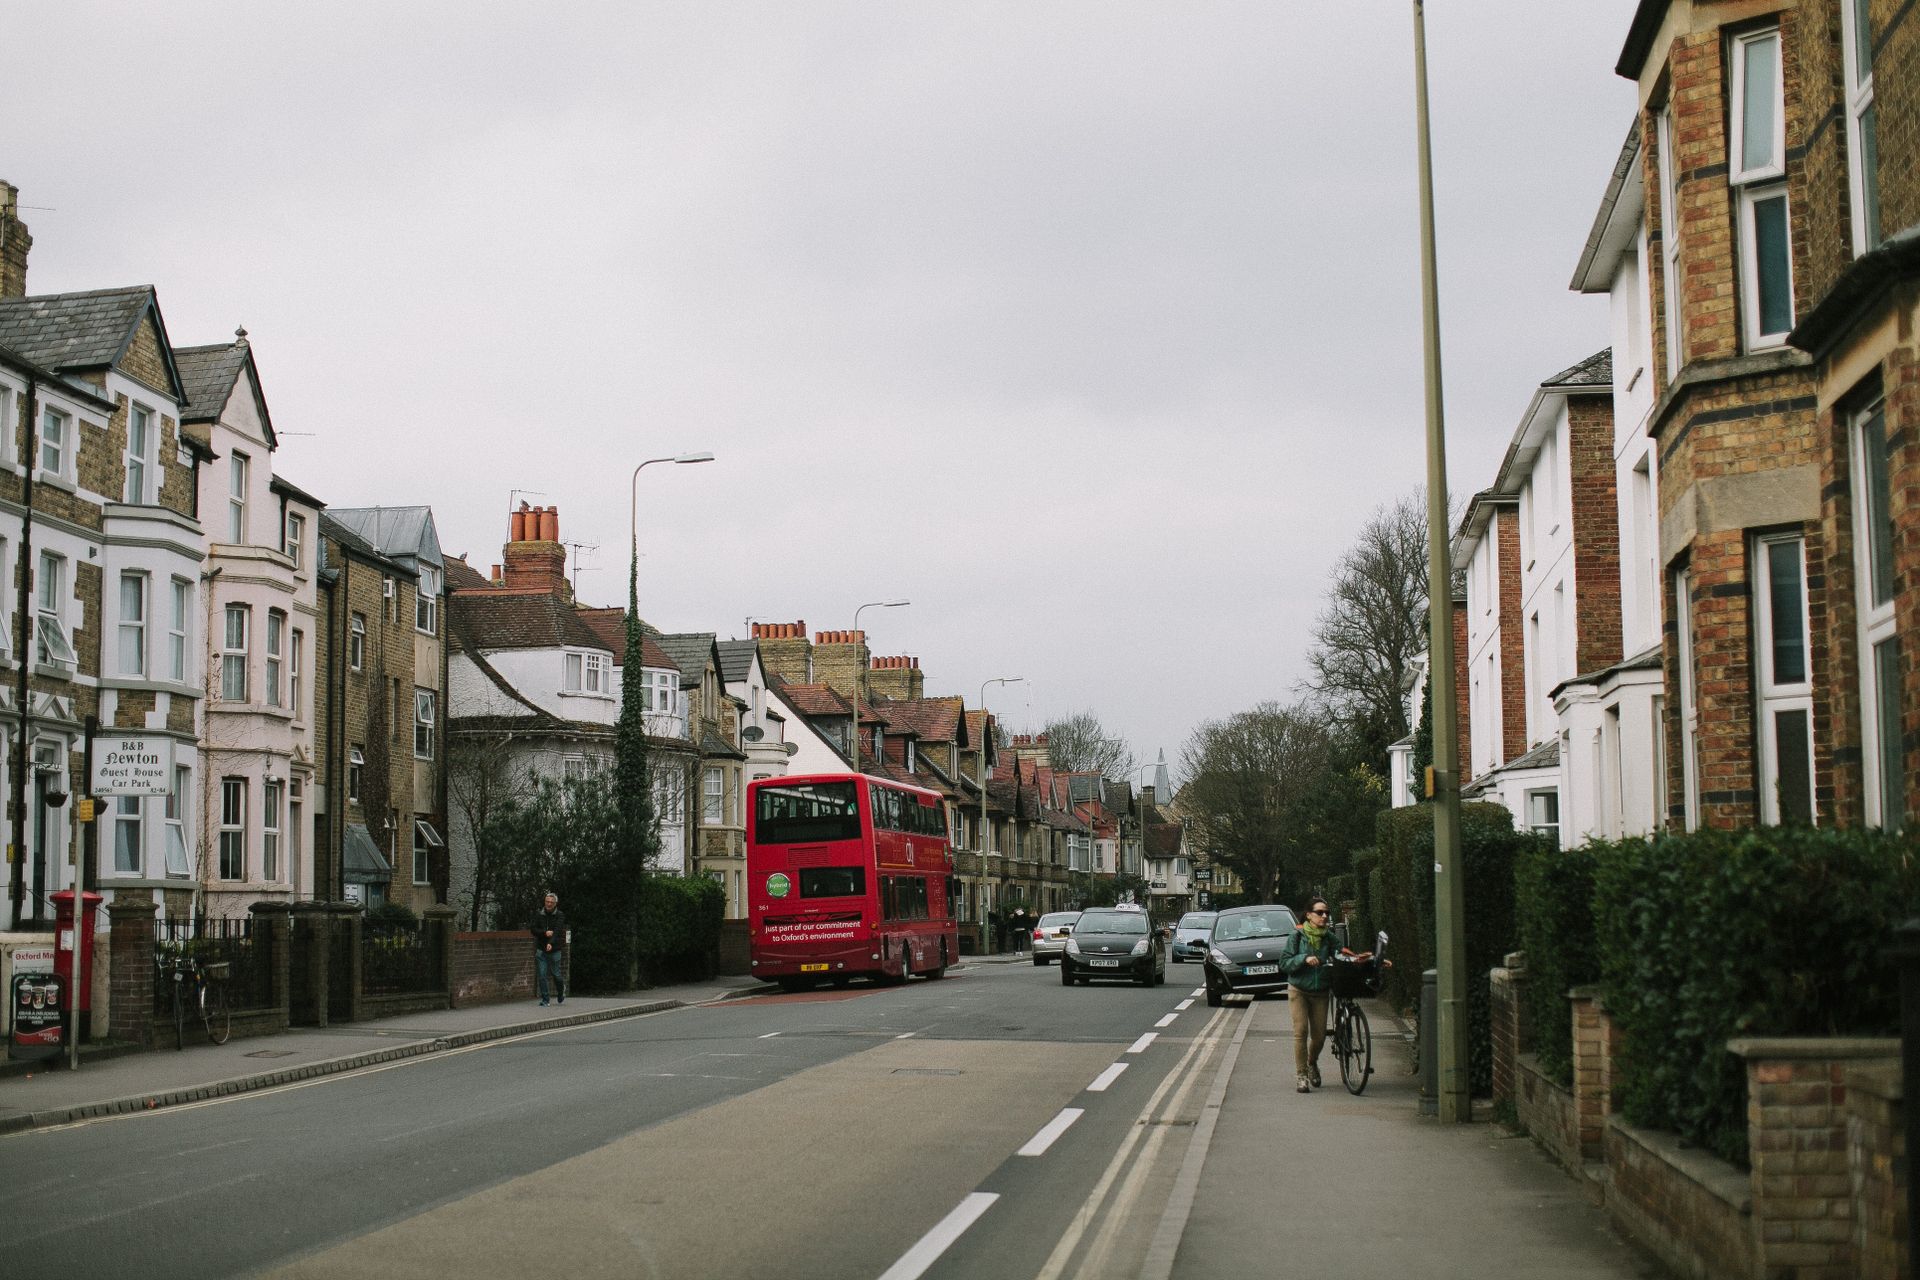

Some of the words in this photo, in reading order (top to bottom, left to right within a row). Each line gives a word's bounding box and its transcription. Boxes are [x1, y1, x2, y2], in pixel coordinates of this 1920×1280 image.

[122, 741, 144, 751] B&B
[104, 752, 158, 765] Newton
[100, 767, 128, 777] Guest
[134, 767, 164, 777] House
[111, 779, 127, 788] Car
[131, 779, 151, 788] Park
[779, 924, 793, 933] part
[794, 923, 802, 931] of
[816, 921, 861, 930] commitment
[781, 933, 808, 942] Oxford's
[810, 931, 854, 940] environment
[15, 952, 41, 960] Oxford
